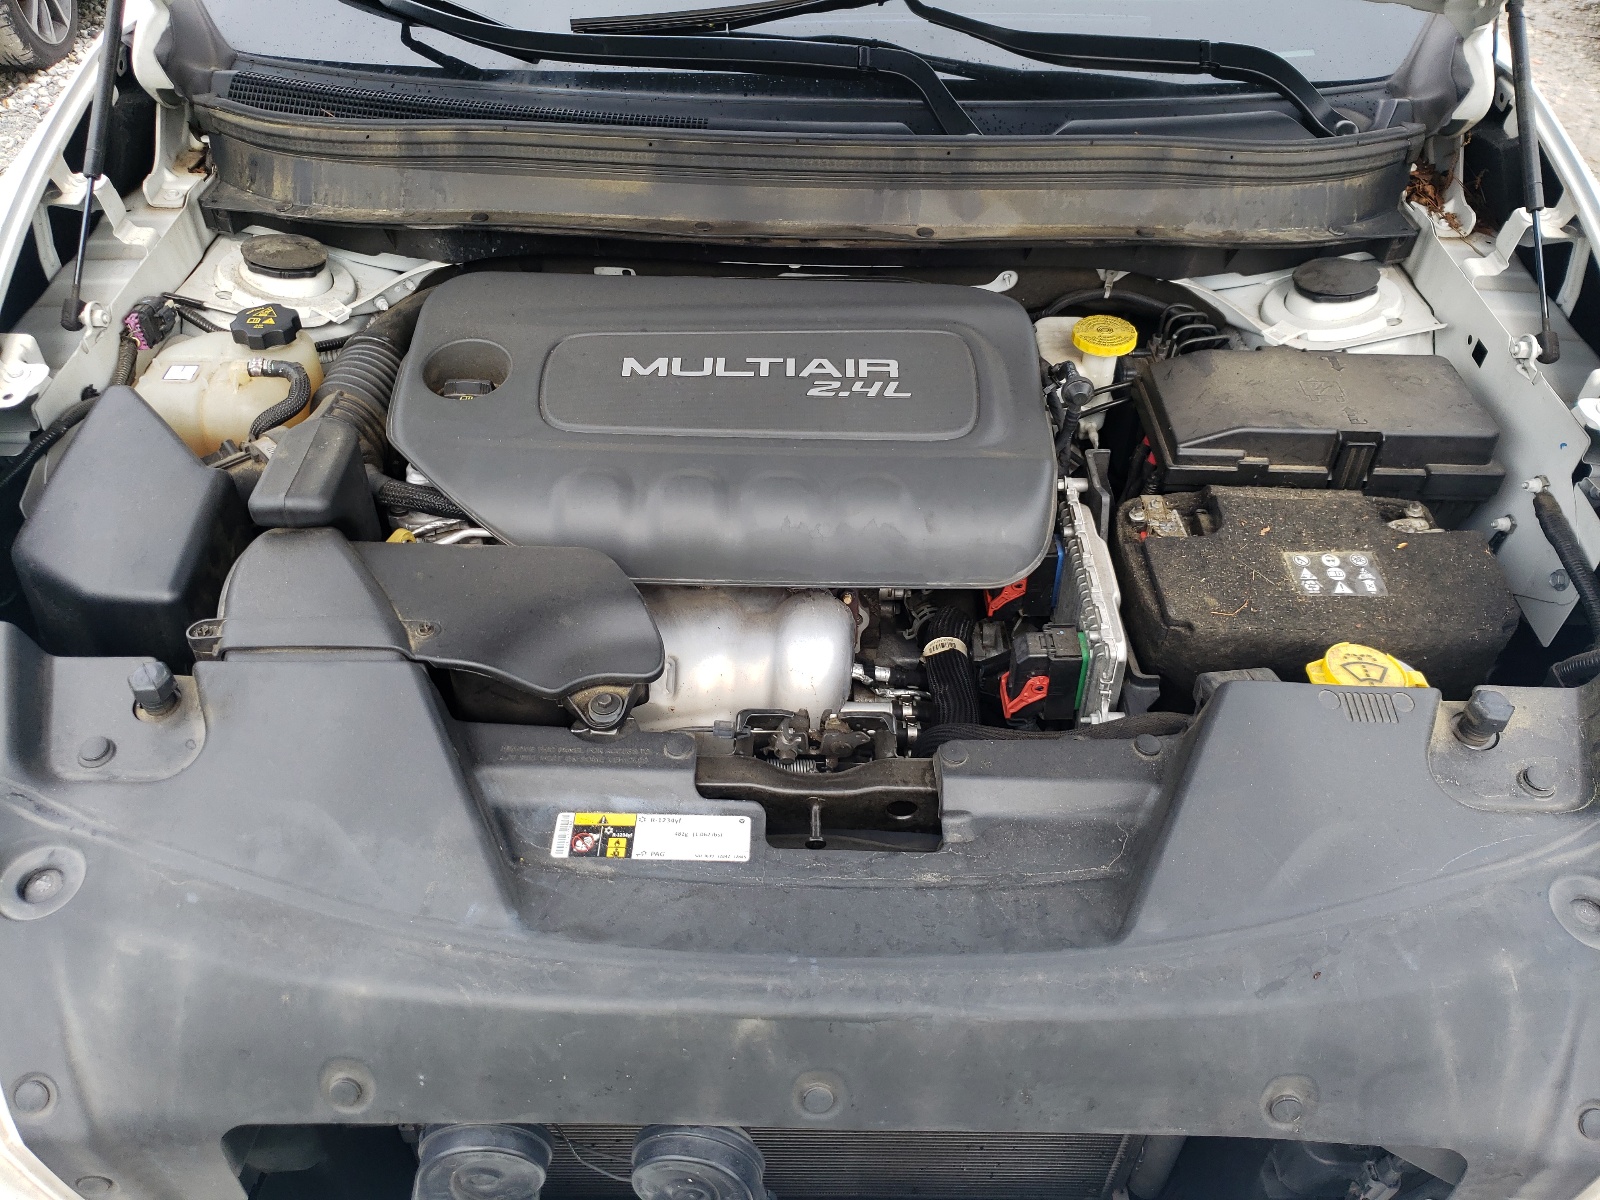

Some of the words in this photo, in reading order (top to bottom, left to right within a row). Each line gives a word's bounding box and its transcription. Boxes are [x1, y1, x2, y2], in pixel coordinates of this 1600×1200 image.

[621, 357, 900, 378] MULTIAIR
[806, 380, 912, 397] 2.4L
[650, 817, 682, 825] R-1234yf
